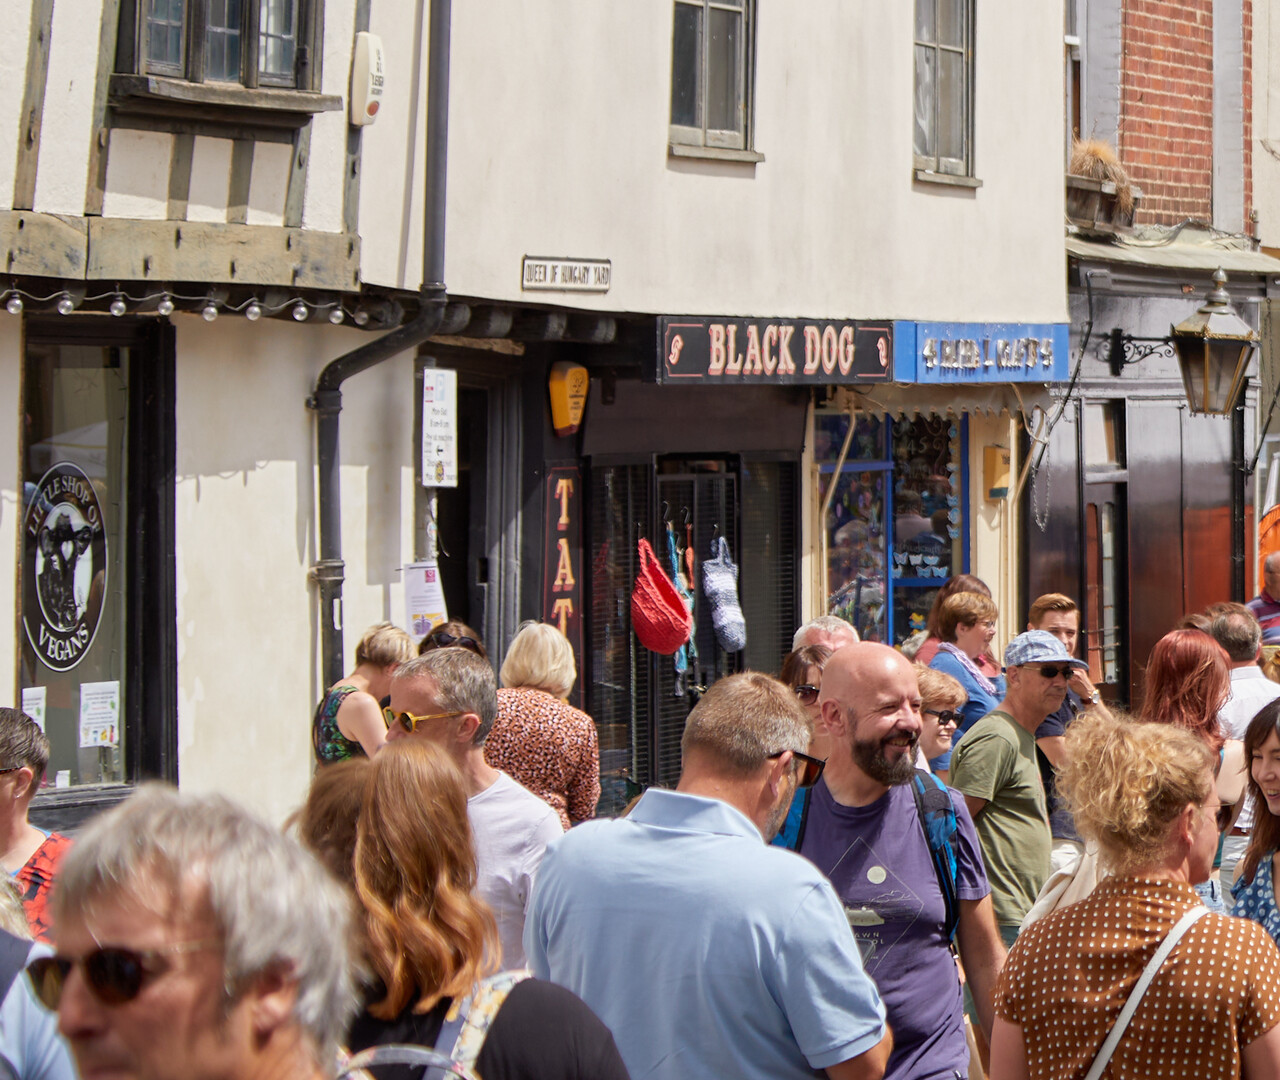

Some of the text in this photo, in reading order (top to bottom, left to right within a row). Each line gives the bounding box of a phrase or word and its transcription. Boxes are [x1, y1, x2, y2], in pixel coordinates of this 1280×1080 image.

[526, 263, 610, 286] QUEEN OF HUNGARY YARD
[707, 323, 855, 375] BLACK DOG
[28, 476, 62, 537] LITTLE
[61, 475, 90, 505] SHOP
[551, 477, 576, 642] TAT
[38, 622, 90, 662] VEGANS
